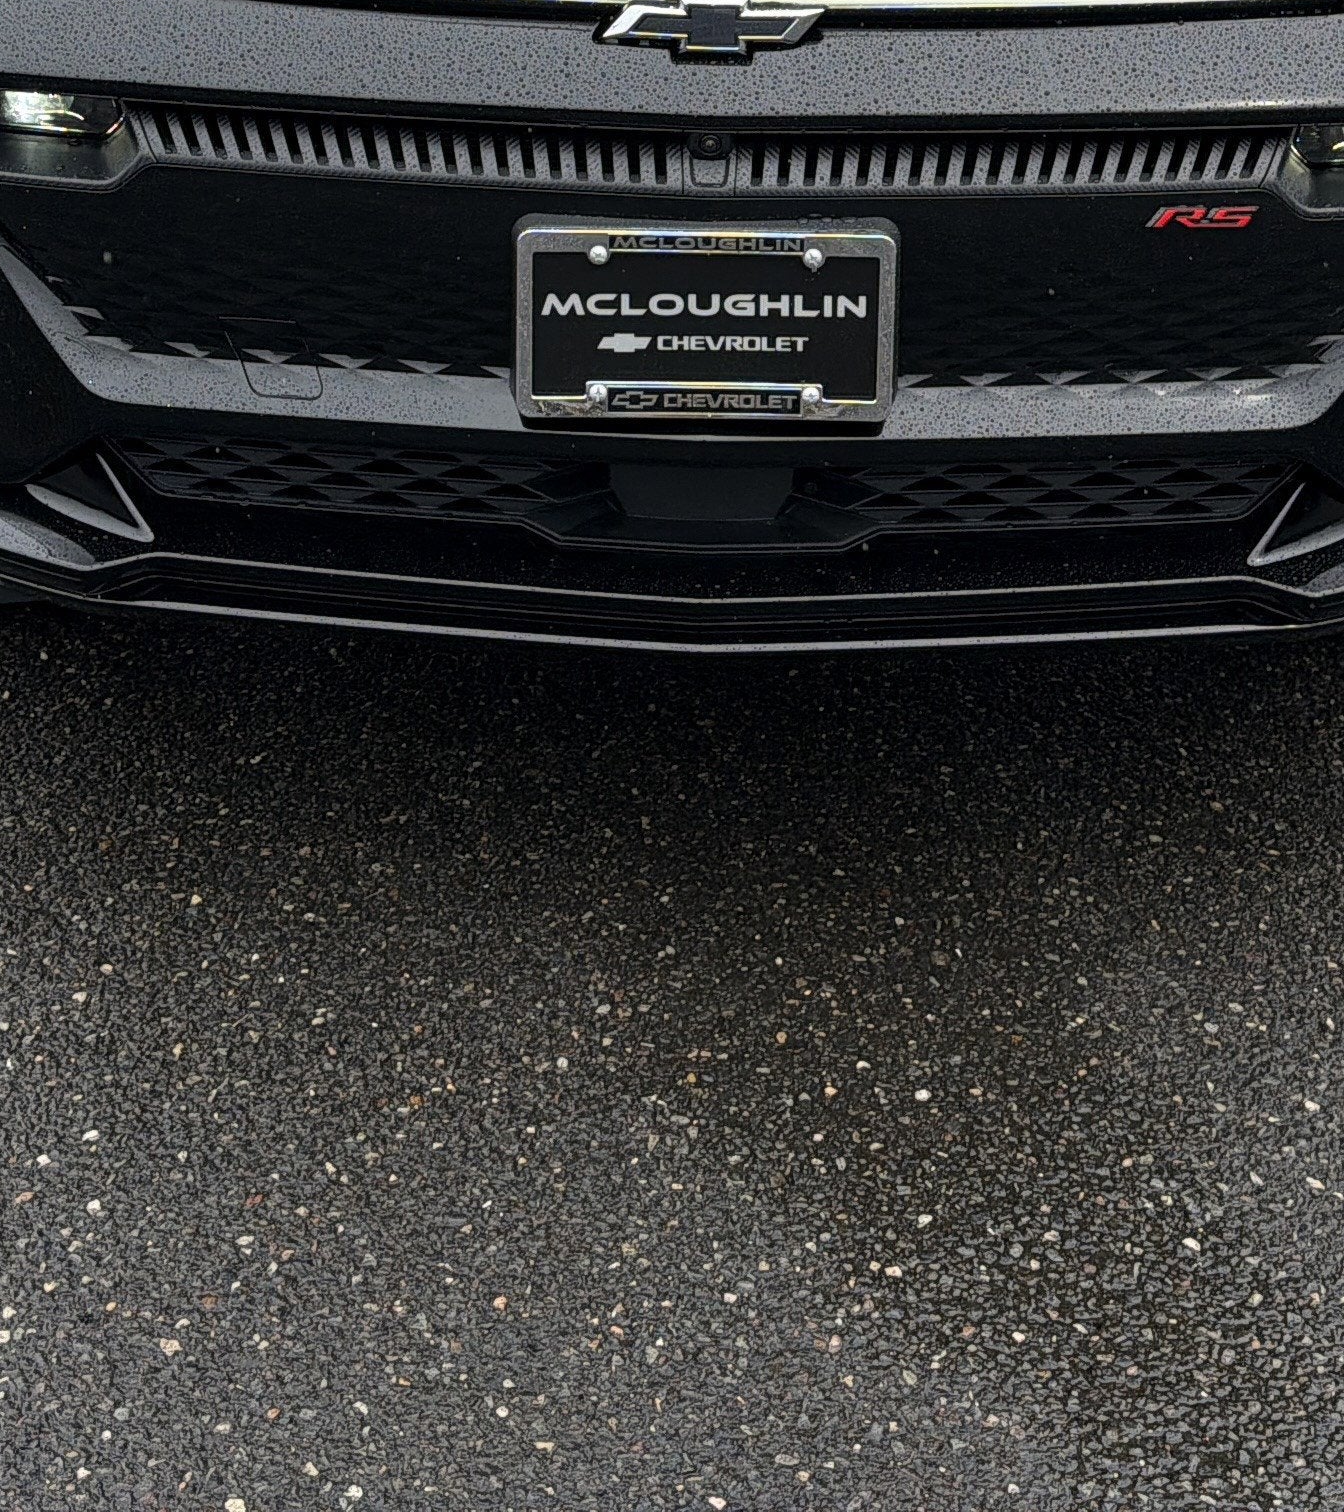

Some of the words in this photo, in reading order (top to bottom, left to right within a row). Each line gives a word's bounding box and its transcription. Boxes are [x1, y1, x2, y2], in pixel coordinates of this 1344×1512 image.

[1145, 204, 1260, 229] RS
[612, 235, 803, 252] MCLOUGHLIN
[540, 292, 868, 319] MCLOUGHLIN
[656, 335, 810, 353] CHEVROLET
[663, 392, 798, 410] CHEVROLET
